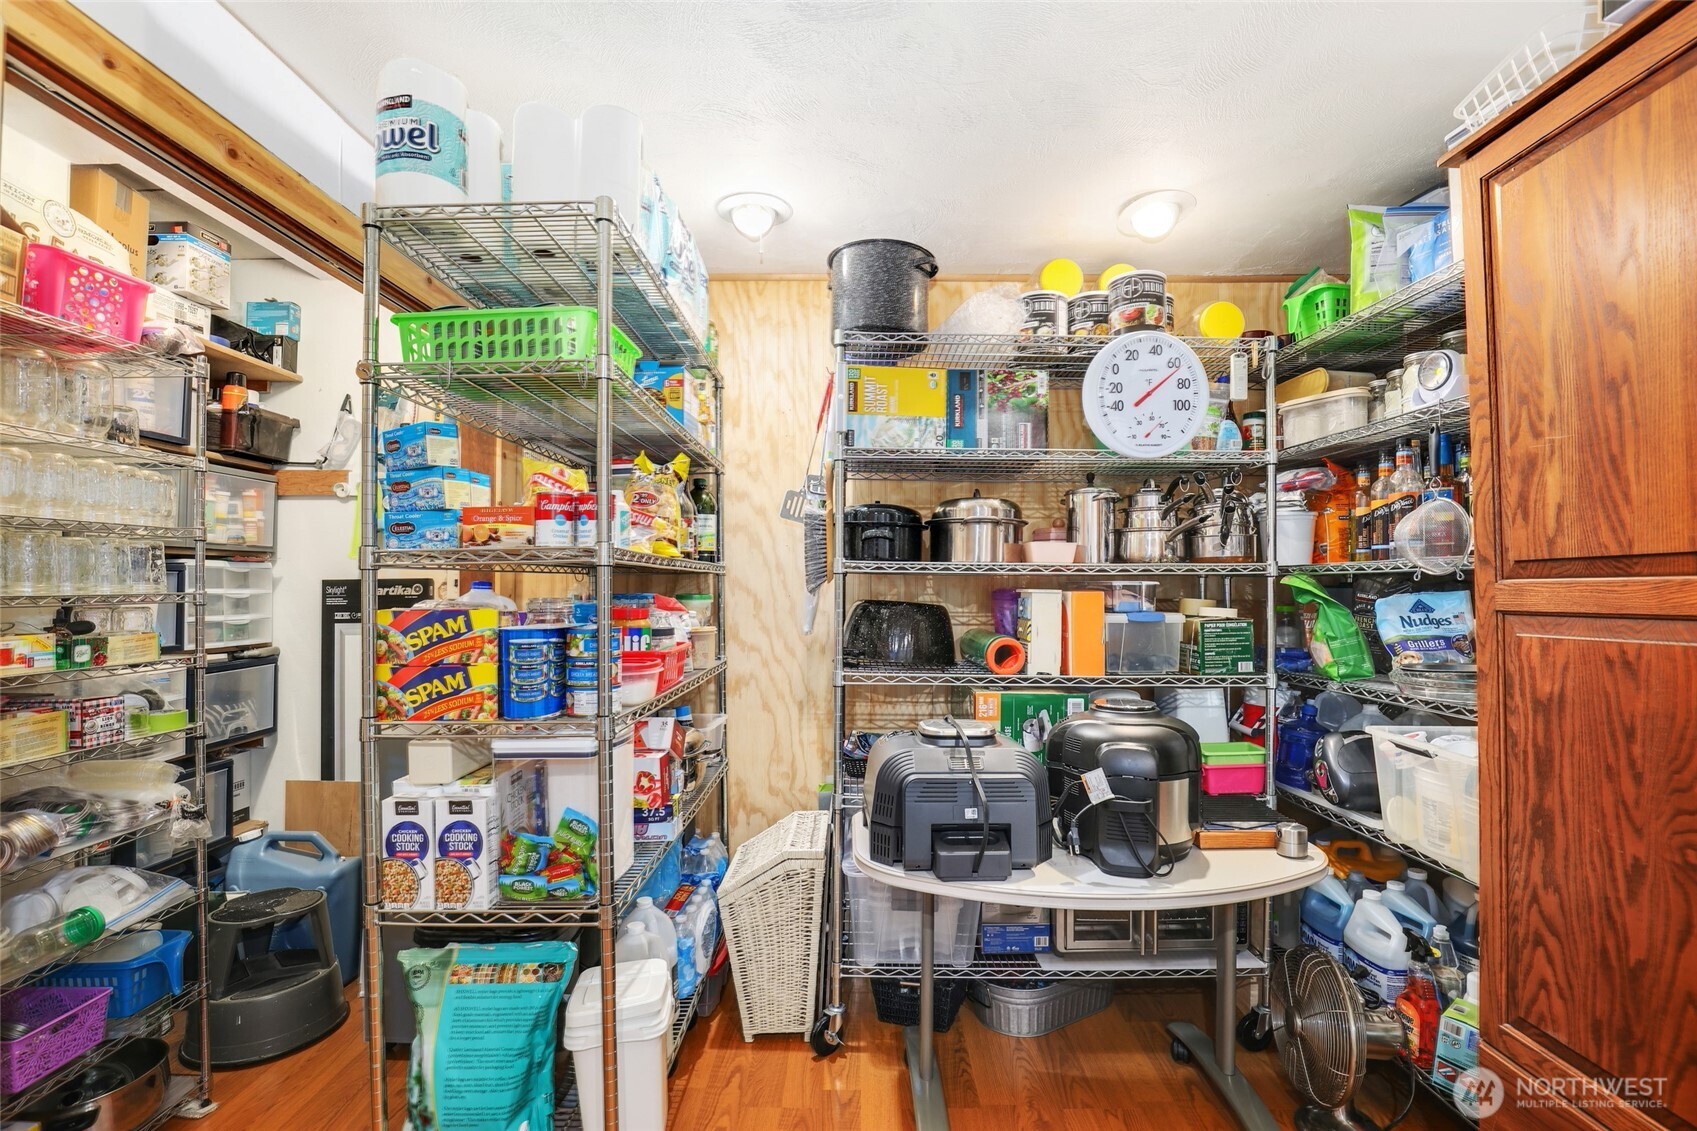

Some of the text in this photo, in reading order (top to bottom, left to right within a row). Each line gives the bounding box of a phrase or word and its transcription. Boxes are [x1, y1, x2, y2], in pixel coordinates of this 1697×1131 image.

[1125, 349, 1139, 361] 20
[1149, 344, 1162, 356] 40
[1112, 363, 1119, 375] 0
[1167, 357, 1181, 369] 60
[1105, 382, 1123, 394] -20
[1177, 378, 1191, 389] 80
[864, 376, 876, 412] SUMMIT
[877, 383, 888, 412] ROAST
[1106, 399, 1124, 411] -40
[1173, 399, 1191, 411] 100
[473, 515, 497, 523] Orange
[505, 514, 523, 523] Spice
[325, 585, 348, 596] Skylight
[377, 584, 414, 596] artika
[1399, 613, 1452, 629] Nudges
[405, 614, 467, 651] SPAM
[1407, 639, 1446, 648] Grillers
[423, 652, 434, 662] 25%
[434, 648, 449, 659] LESS
[449, 640, 475, 651] SODIUM
[404, 671, 467, 708] SPAM
[423, 709, 434, 719] 25%
[434, 704, 448, 715] LESS
[449, 697, 474, 709] SODIUM
[642, 807, 666, 818] 37.5
[391, 833, 424, 843] COOKING
[444, 833, 478, 842] COOKING
[396, 842, 420, 851] STOCK
[449, 841, 474, 851] STOCK
